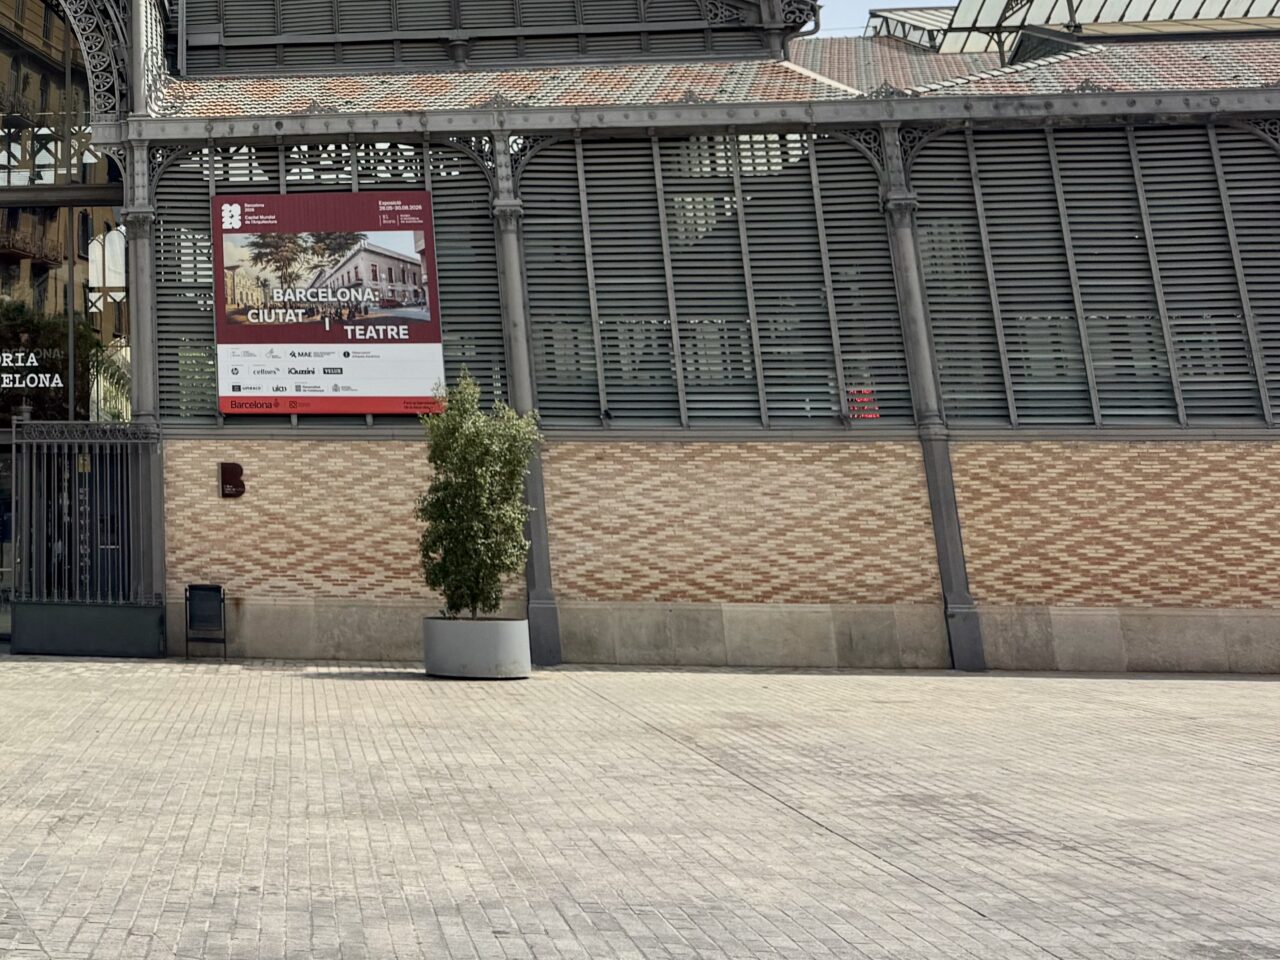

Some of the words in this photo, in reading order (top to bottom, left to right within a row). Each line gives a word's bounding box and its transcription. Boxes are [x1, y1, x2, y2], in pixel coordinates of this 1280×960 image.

[272, 287, 379, 302] BARCELONA:
[247, 309, 306, 323] CIUTAT
[325, 317, 330, 331] I
[343, 325, 409, 340] TEATRE
[230, 400, 272, 409] Barcelona
